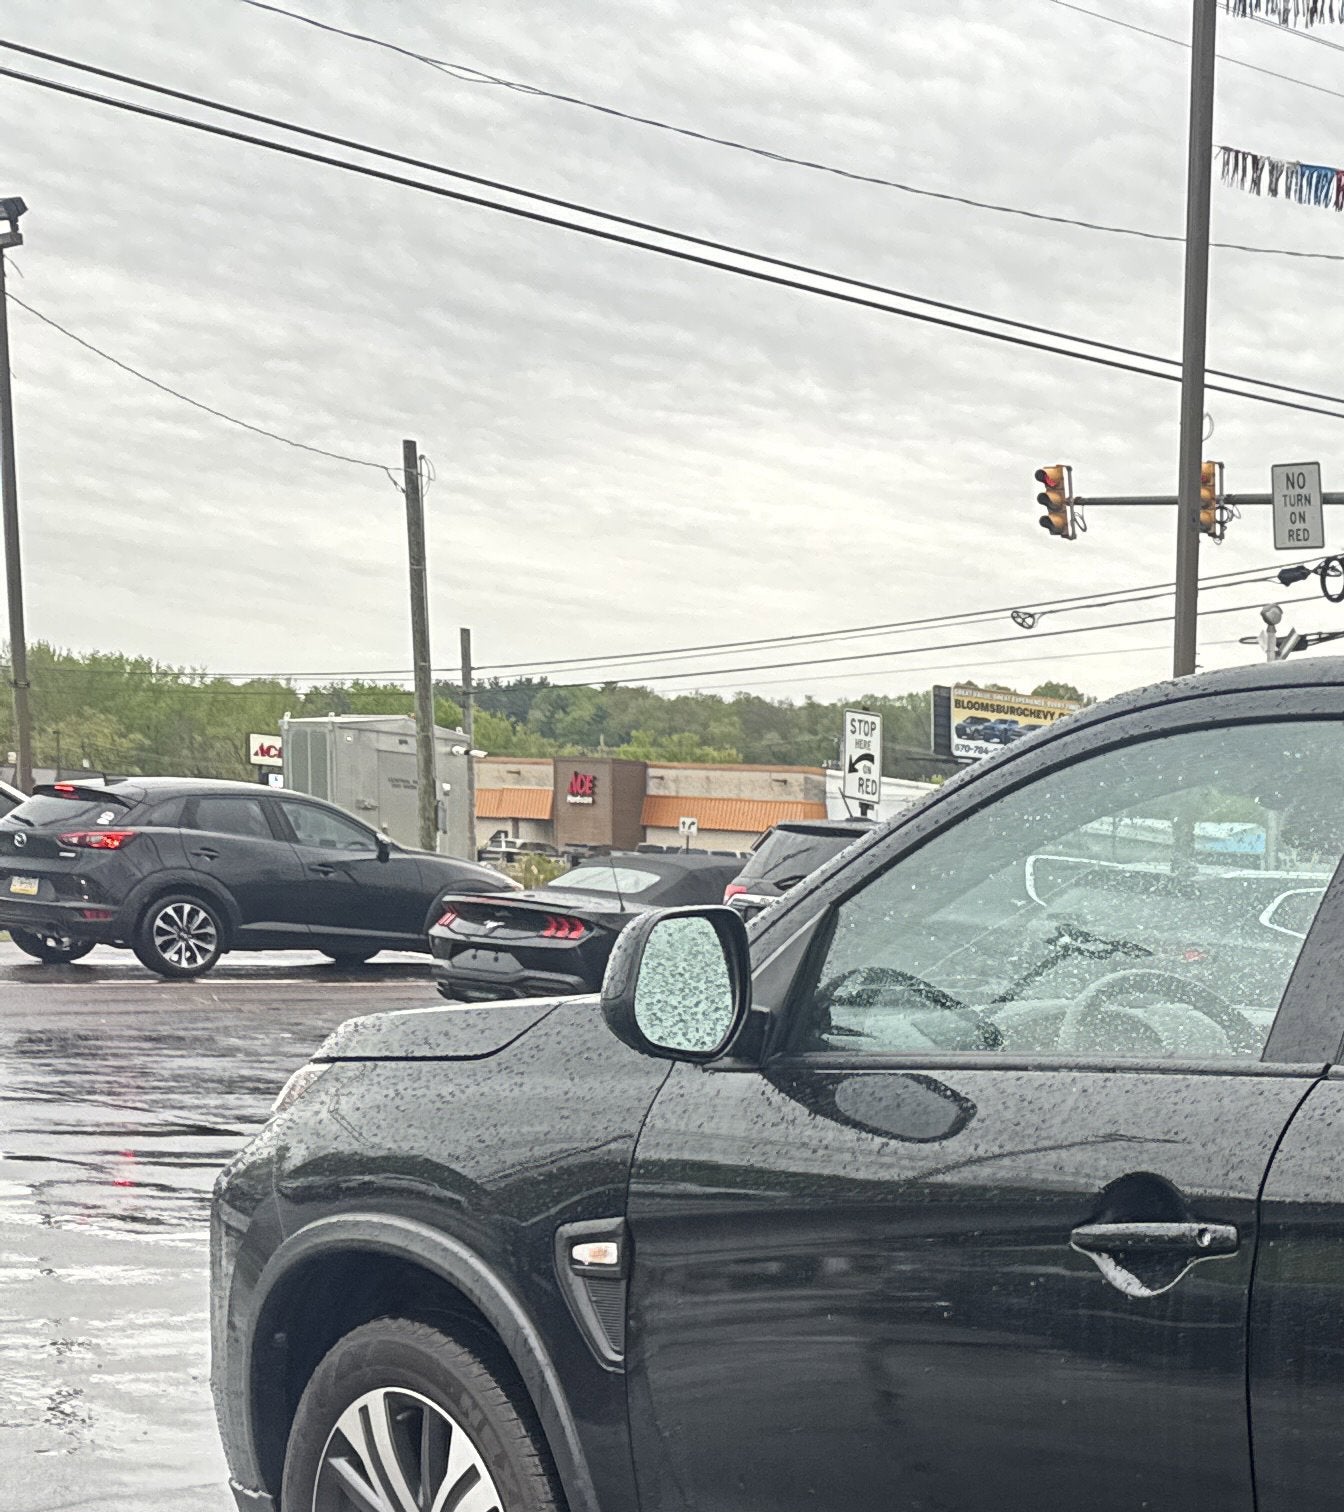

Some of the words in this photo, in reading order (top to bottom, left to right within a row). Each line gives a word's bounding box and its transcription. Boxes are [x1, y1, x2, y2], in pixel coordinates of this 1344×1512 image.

[1286, 471, 1306, 490] NO
[1282, 493, 1312, 507] TURN
[1290, 511, 1306, 525] ON
[1288, 528, 1310, 542] RED
[850, 718, 876, 737] STOP
[855, 739, 871, 751] HERE
[863, 764, 871, 774] ON
[567, 771, 593, 795] ACE
[858, 777, 877, 795] RED
